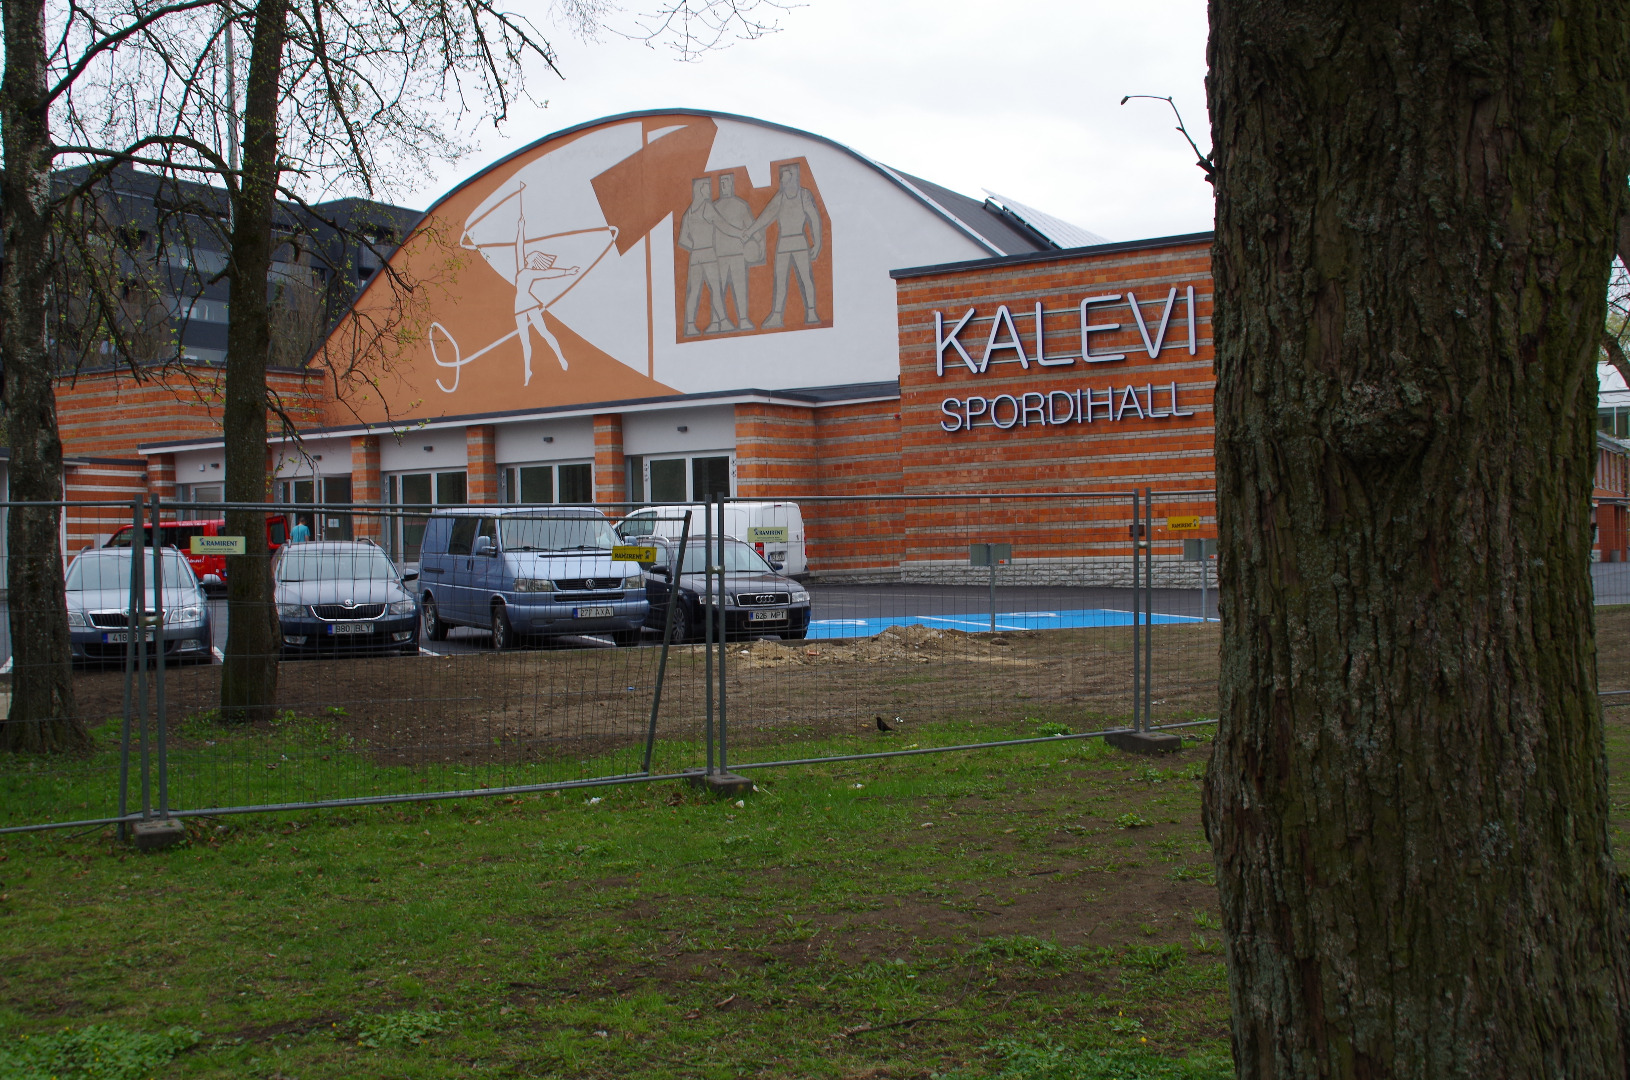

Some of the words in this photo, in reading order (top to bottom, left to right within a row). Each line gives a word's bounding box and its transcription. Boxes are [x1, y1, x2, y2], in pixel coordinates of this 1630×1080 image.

[935, 285, 1196, 377] KALEVI
[940, 381, 1195, 432] SPORDIHALL
[112, 633, 128, 642] 418
[355, 624, 371, 632] BLY
